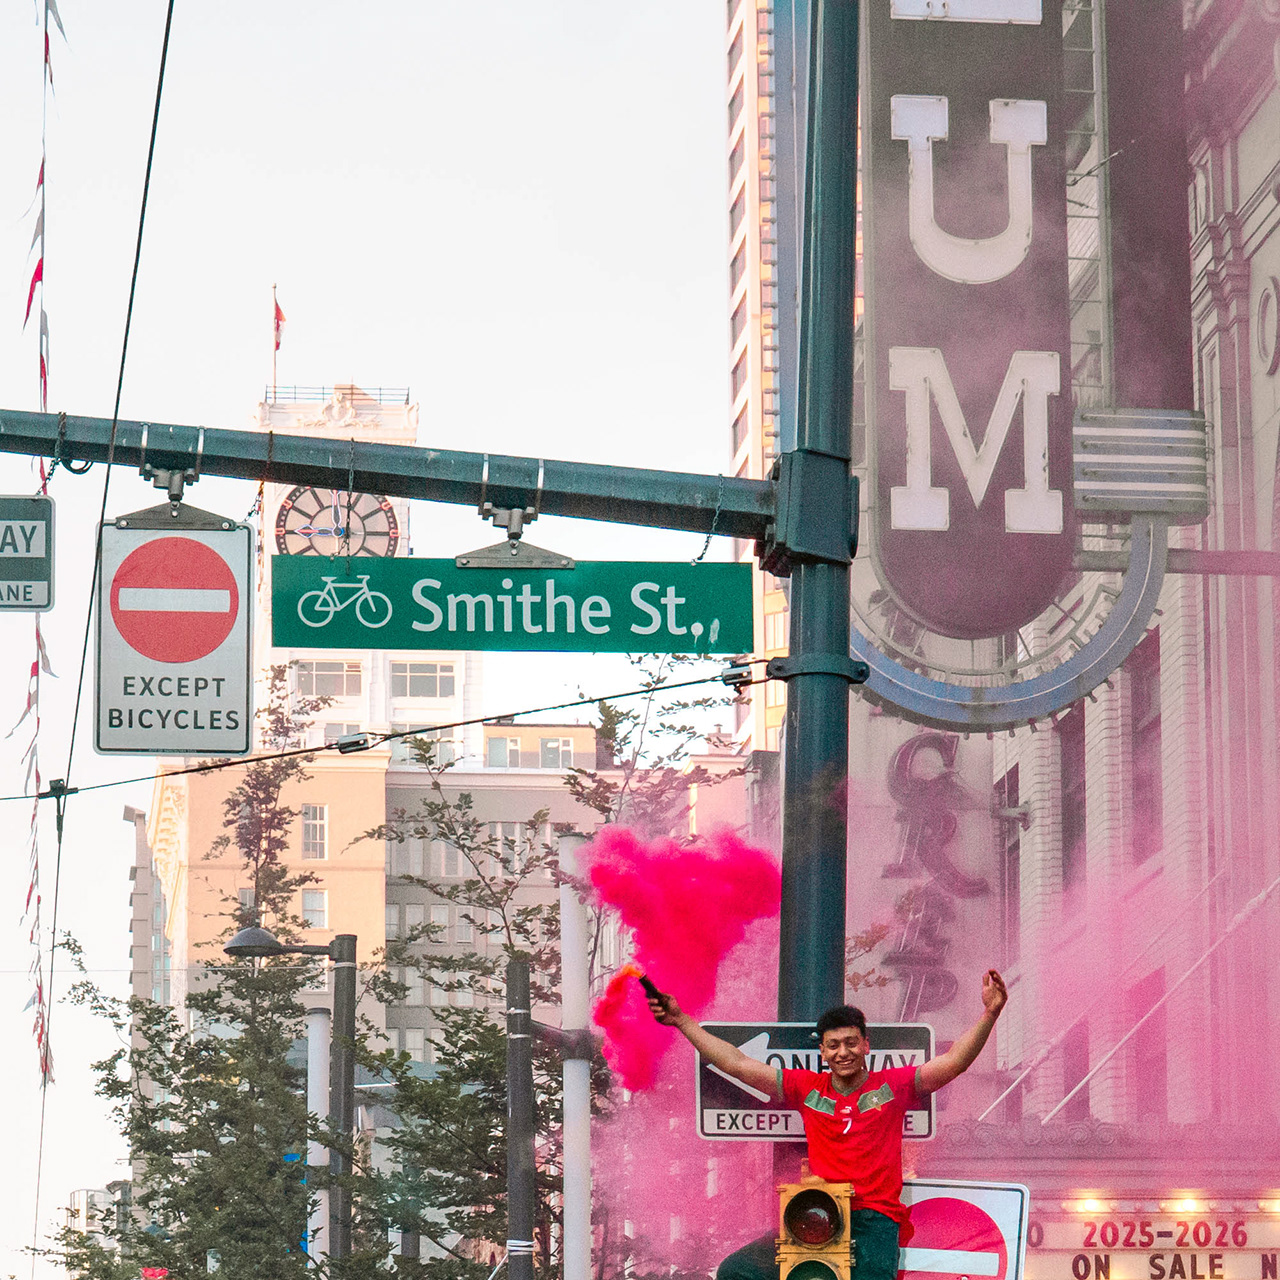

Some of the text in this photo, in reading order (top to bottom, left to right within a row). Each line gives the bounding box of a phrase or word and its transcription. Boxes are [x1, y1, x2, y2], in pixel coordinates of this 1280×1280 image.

[888, 0, 1064, 534] UM
[411, 578, 612, 635] Smithe
[123, 676, 226, 697] EXCEPT
[108, 708, 240, 731] BICYCLES
[716, 1113, 792, 1132] EXCEPT
[842, 1117, 852, 1135] 7
[1083, 1220, 1248, 1248] 2025-2026
[1072, 1253, 1111, 1280] ON
[1149, 1253, 1224, 1280] SALE
